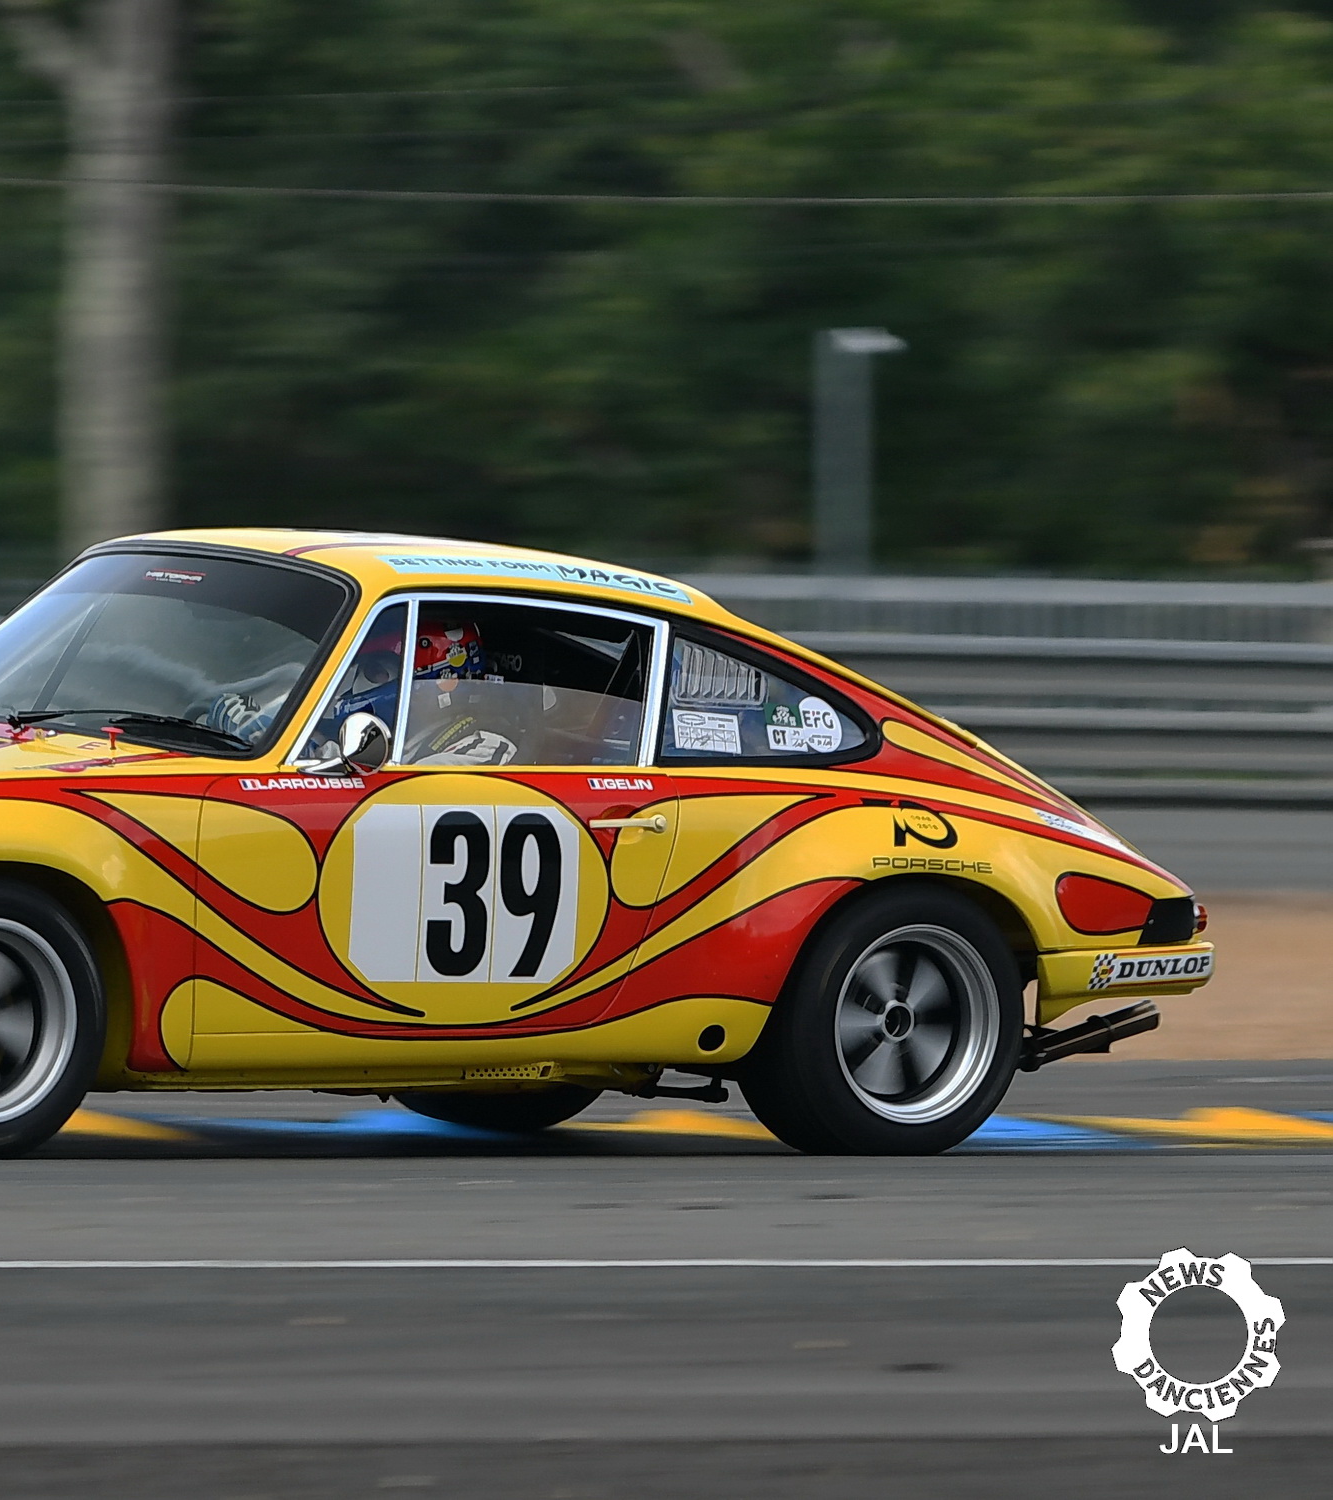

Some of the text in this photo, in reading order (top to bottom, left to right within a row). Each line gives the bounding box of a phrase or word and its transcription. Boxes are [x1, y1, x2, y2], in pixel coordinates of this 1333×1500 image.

[486, 559, 552, 573] FORM
[556, 564, 680, 595] MAGIC
[772, 728, 787, 746] CT
[256, 777, 366, 790] LARROUSSE
[603, 778, 654, 791] GELIN
[872, 857, 994, 875] PORSCHE
[425, 810, 562, 978] 39
[1115, 955, 1211, 979] DUNLOP
